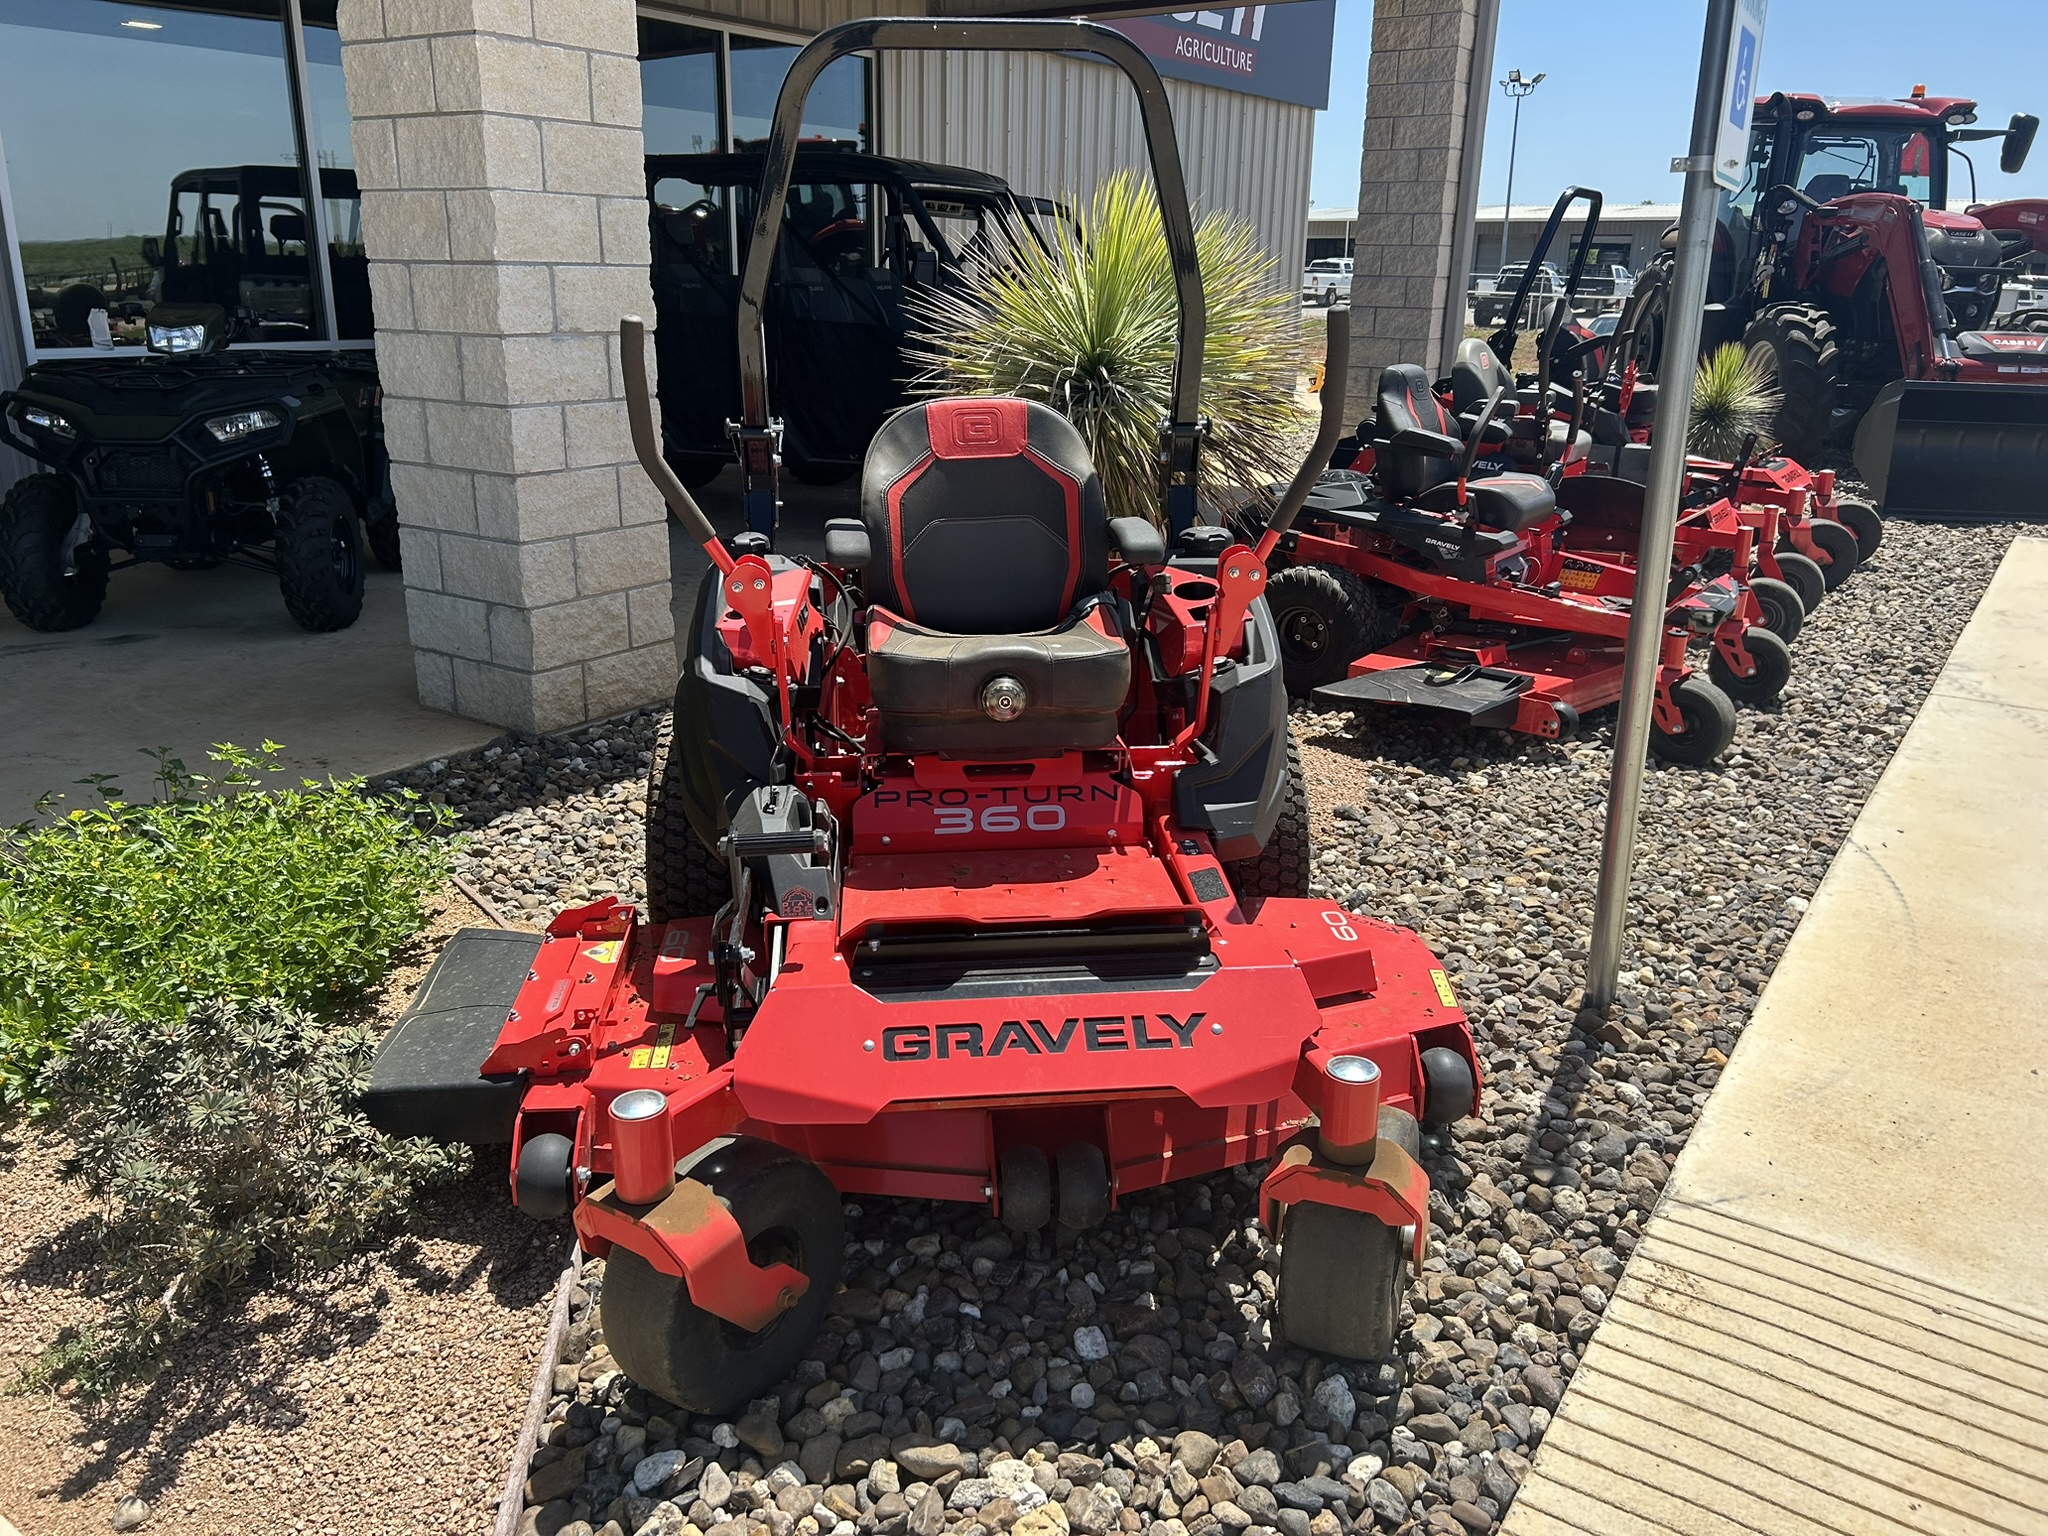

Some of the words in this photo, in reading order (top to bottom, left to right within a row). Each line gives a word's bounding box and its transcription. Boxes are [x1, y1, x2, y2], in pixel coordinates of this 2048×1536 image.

[1175, 35, 1253, 72] AGRICULTURE
[1472, 460, 1504, 471] VELY
[1425, 537, 1461, 551] GRAVELY
[874, 784, 1118, 809] PRO-TURN
[933, 804, 1066, 835] 360
[1321, 911, 1358, 941] 60
[662, 931, 689, 963] 60
[882, 1011, 1208, 1062] GRAVELY
